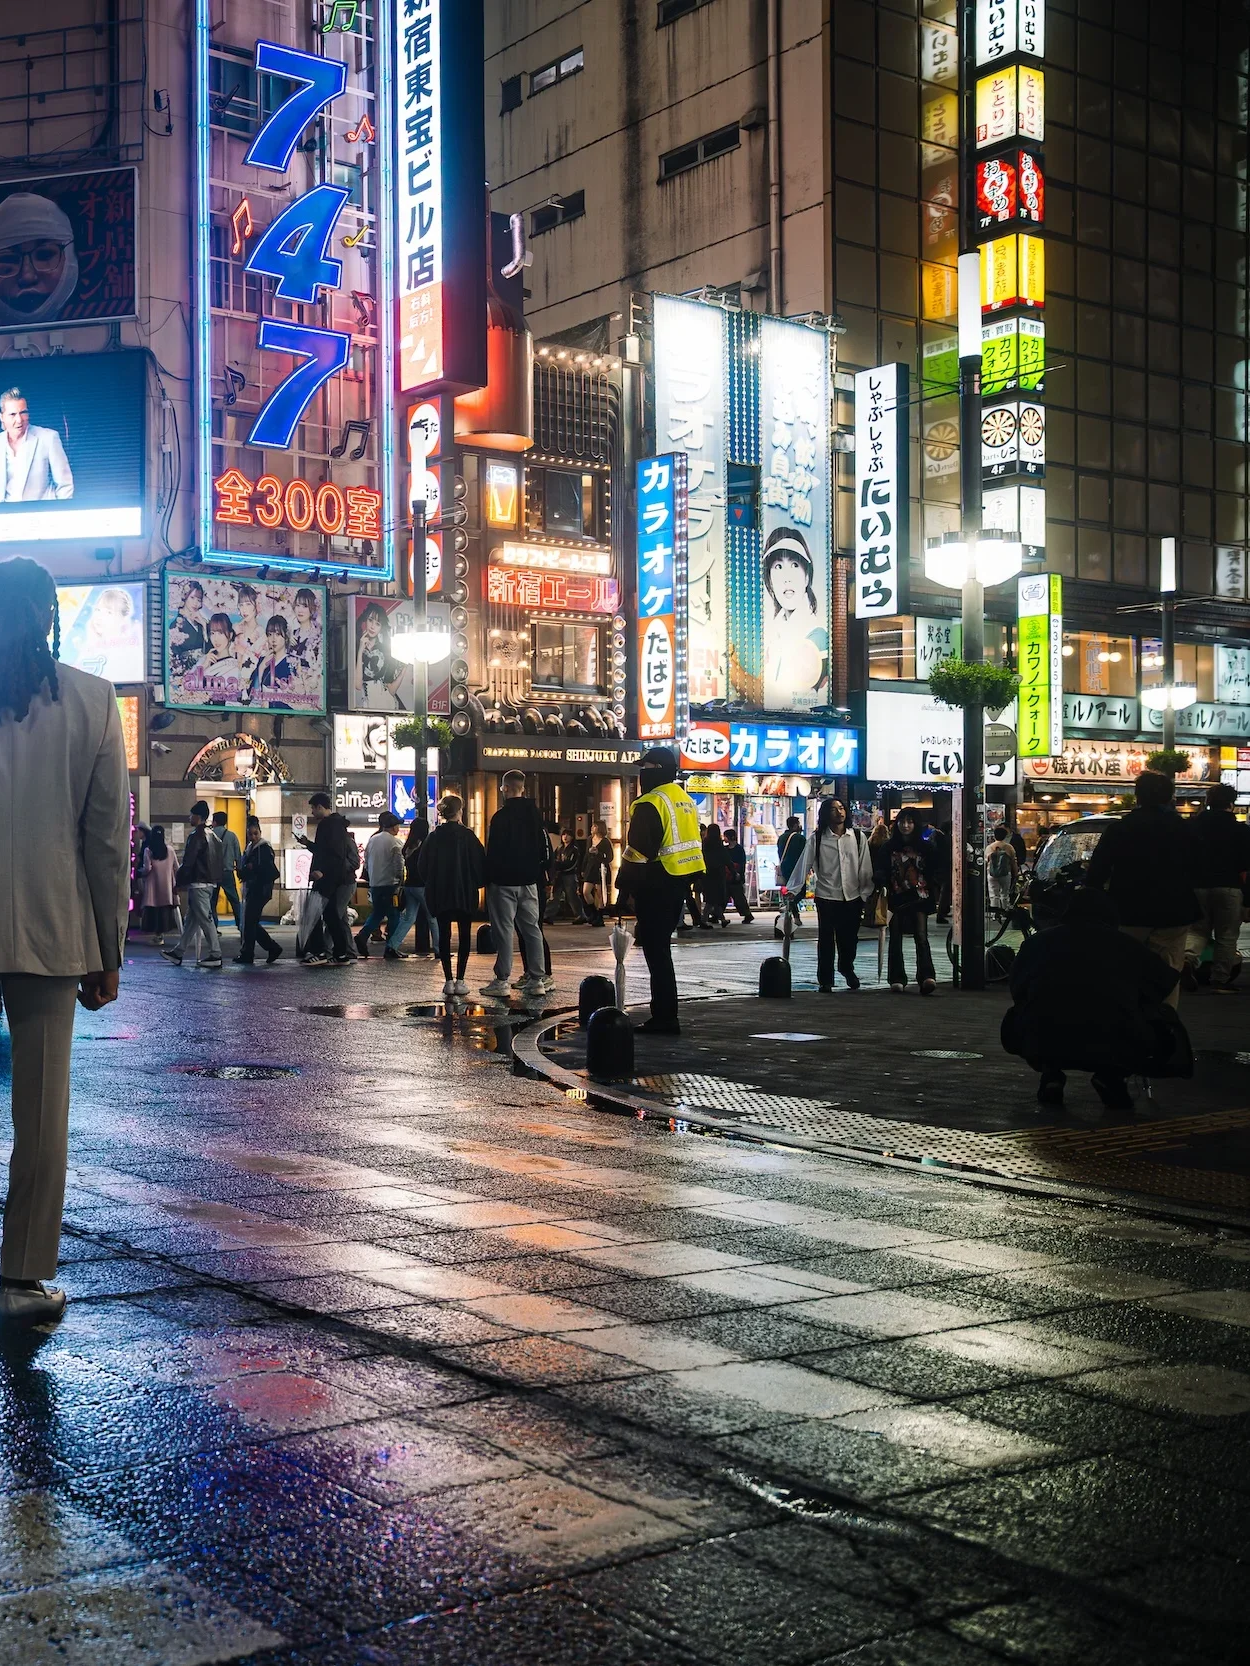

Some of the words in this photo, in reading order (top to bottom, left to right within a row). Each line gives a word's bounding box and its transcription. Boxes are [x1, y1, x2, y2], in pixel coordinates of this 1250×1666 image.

[1024, 0, 1036, 52] いむら
[990, 78, 1006, 140] ととりこ
[1025, 74, 1036, 135] ととりこ
[984, 160, 1008, 211] おすすめ
[1022, 154, 1038, 210] おすすめ
[979, 216, 992, 228] 7F
[1019, 208, 1029, 218] 7F
[77, 191, 105, 301] オープン
[867, 375, 884, 473] しゃぶしゃぶ
[990, 464, 1006, 476] 4F
[1026, 463, 1037, 474] 4F
[214, 467, 382, 541] 全300室
[641, 461, 673, 617] カラオケ
[859, 477, 893, 608] にいむら
[1028, 546, 1038, 556] 3F
[489, 567, 618, 611] 新宿エール
[647, 630, 669, 710] たばこ
[919, 645, 959, 662] ルノアール
[183, 666, 240, 693] alma
[1026, 641, 1041, 752] カワノ・クォーク
[431, 699, 448, 710] B1F
[1072, 698, 1132, 725] ルノアール
[641, 724, 673, 737] 直売所
[920, 735, 962, 746] しゃぶしゃぶ・す
[566, 749, 617, 763] SHINJUKU
[684, 736, 726, 756] たばこ
[730, 727, 859, 771] カラオケ
[335, 777, 348, 787] 2F
[335, 790, 371, 808] alma
